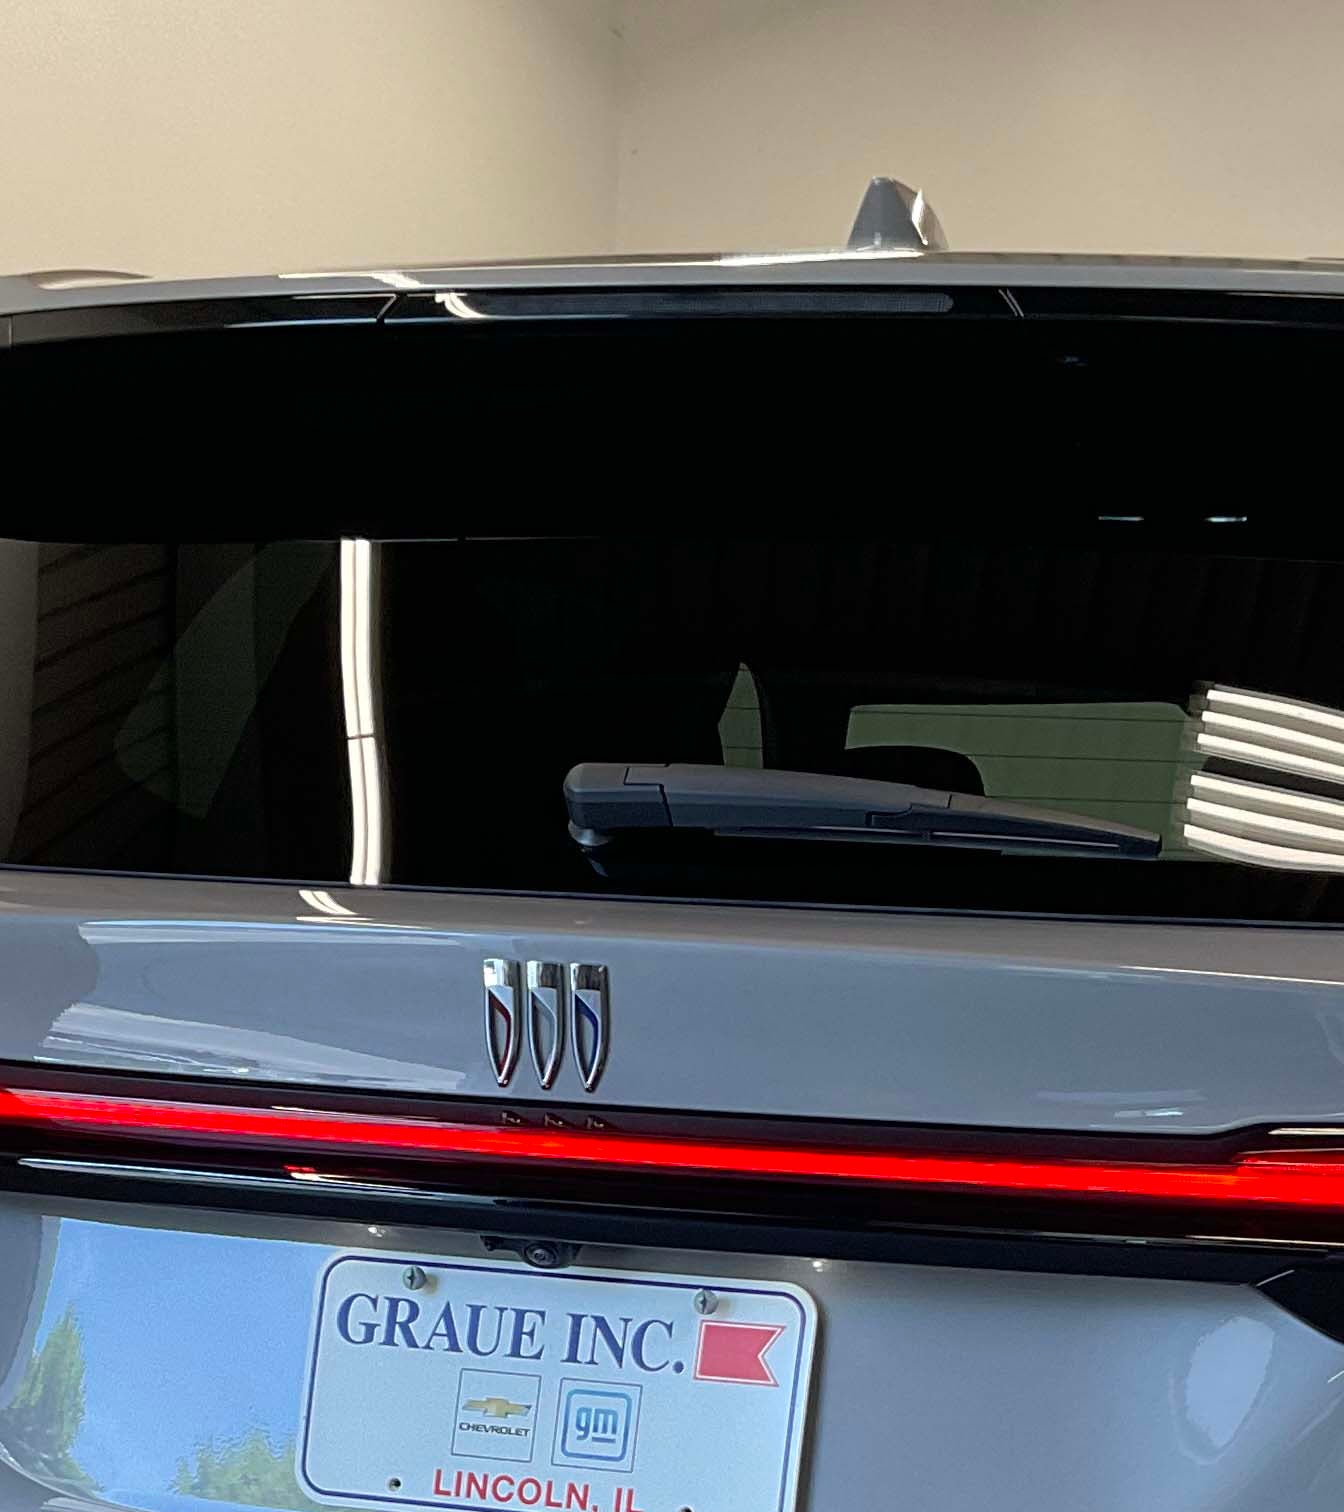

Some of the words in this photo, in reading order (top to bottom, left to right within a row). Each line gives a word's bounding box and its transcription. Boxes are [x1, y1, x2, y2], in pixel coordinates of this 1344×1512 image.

[336, 1291, 547, 1362] GRAUE
[559, 1311, 685, 1375] INC.
[458, 1420, 531, 1439] CHEVROLET
[574, 1403, 620, 1444] gm
